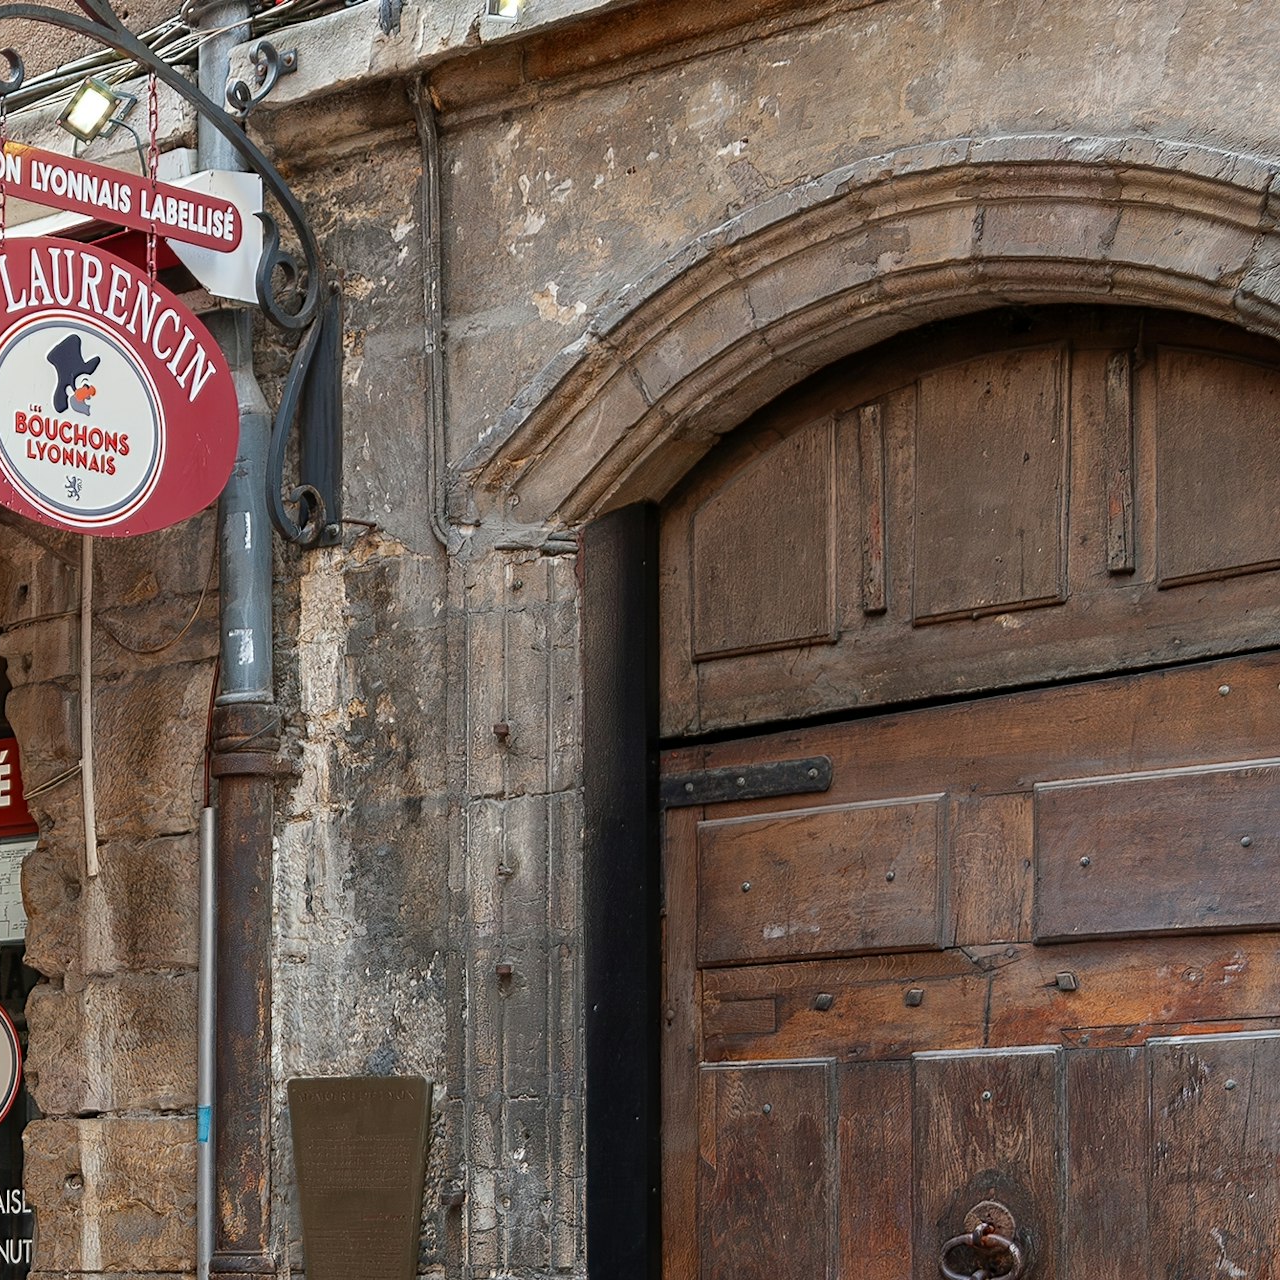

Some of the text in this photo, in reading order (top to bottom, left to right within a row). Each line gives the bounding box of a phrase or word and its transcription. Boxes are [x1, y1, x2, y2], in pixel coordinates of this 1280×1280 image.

[30, 159, 132, 214] LYONNAIS
[140, 189, 235, 242] LABELLISÉ
[14, 411, 130, 456] BOUCHONS
[26, 438, 116, 476] LYONNAIS
